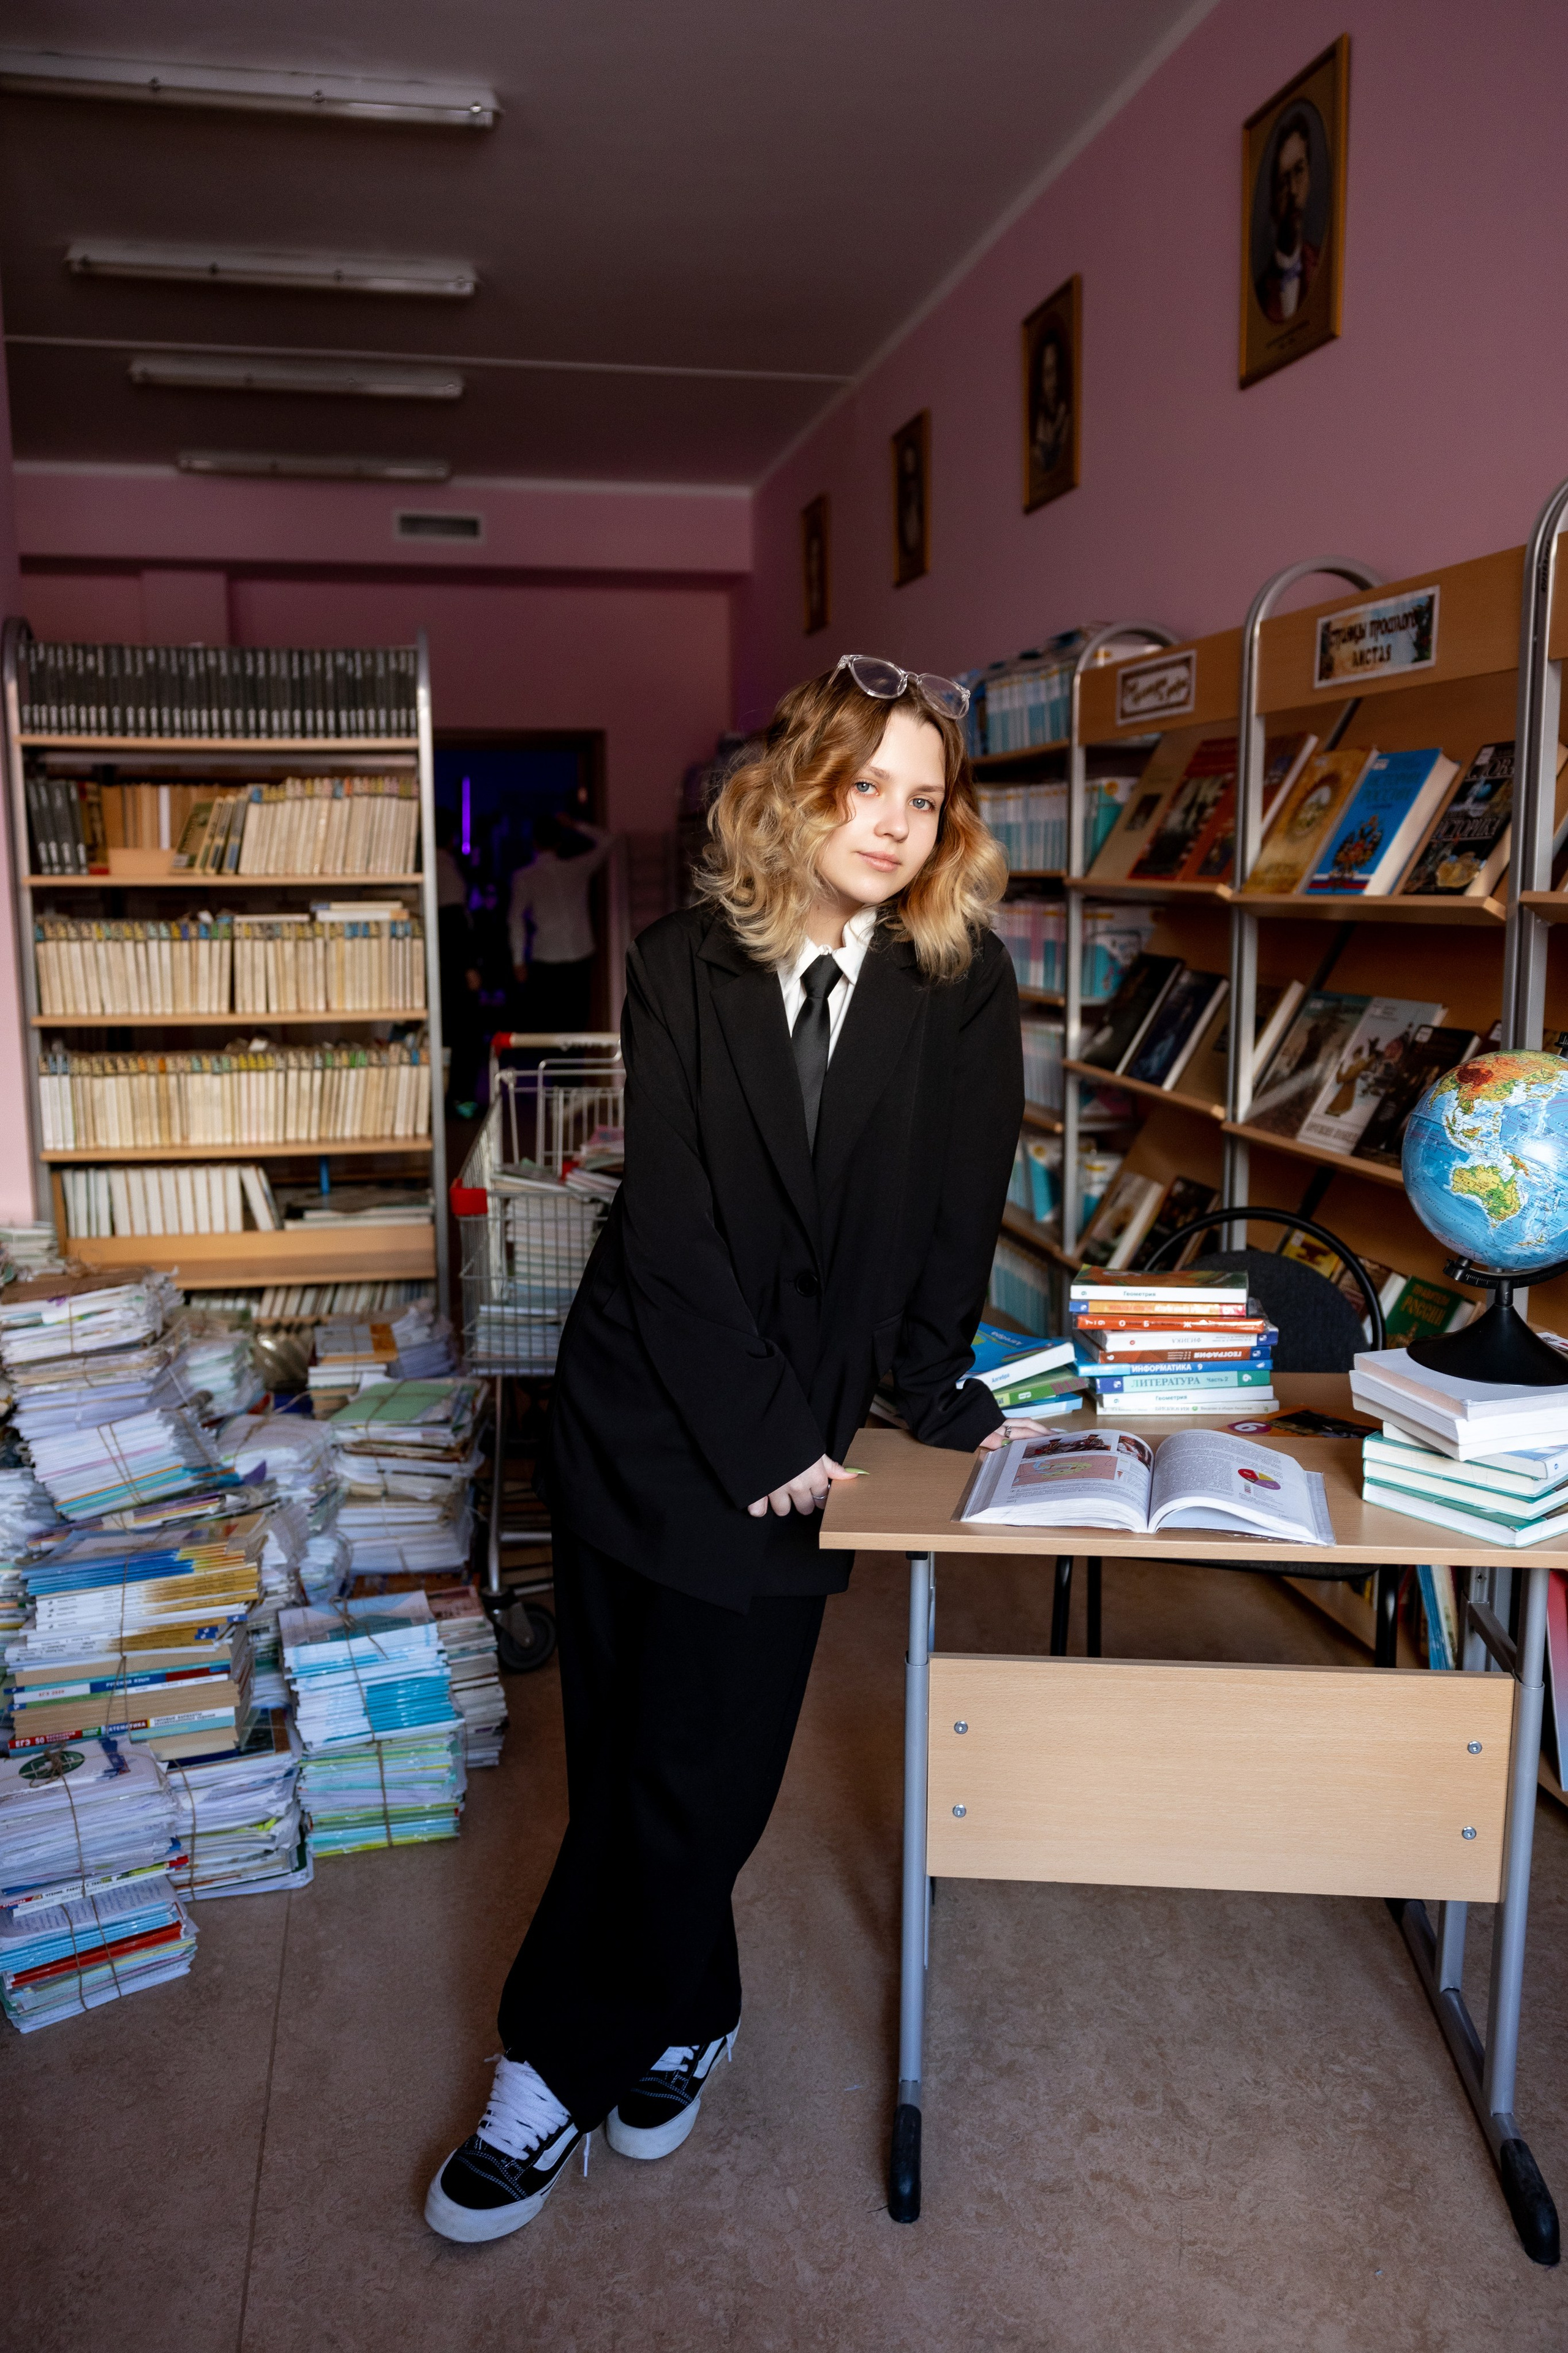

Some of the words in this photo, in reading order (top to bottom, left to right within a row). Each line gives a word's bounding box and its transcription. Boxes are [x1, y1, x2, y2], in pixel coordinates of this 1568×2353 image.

[1194, 1350, 1242, 1359] ГЕОГРАФИЯ
[1131, 1362, 1192, 1373] ИНФОРМАТИКА
[1131, 1376, 1200, 1388] ЛИТЕРАТУРА
[15, 1737, 31, 1748] ЕГЭ
